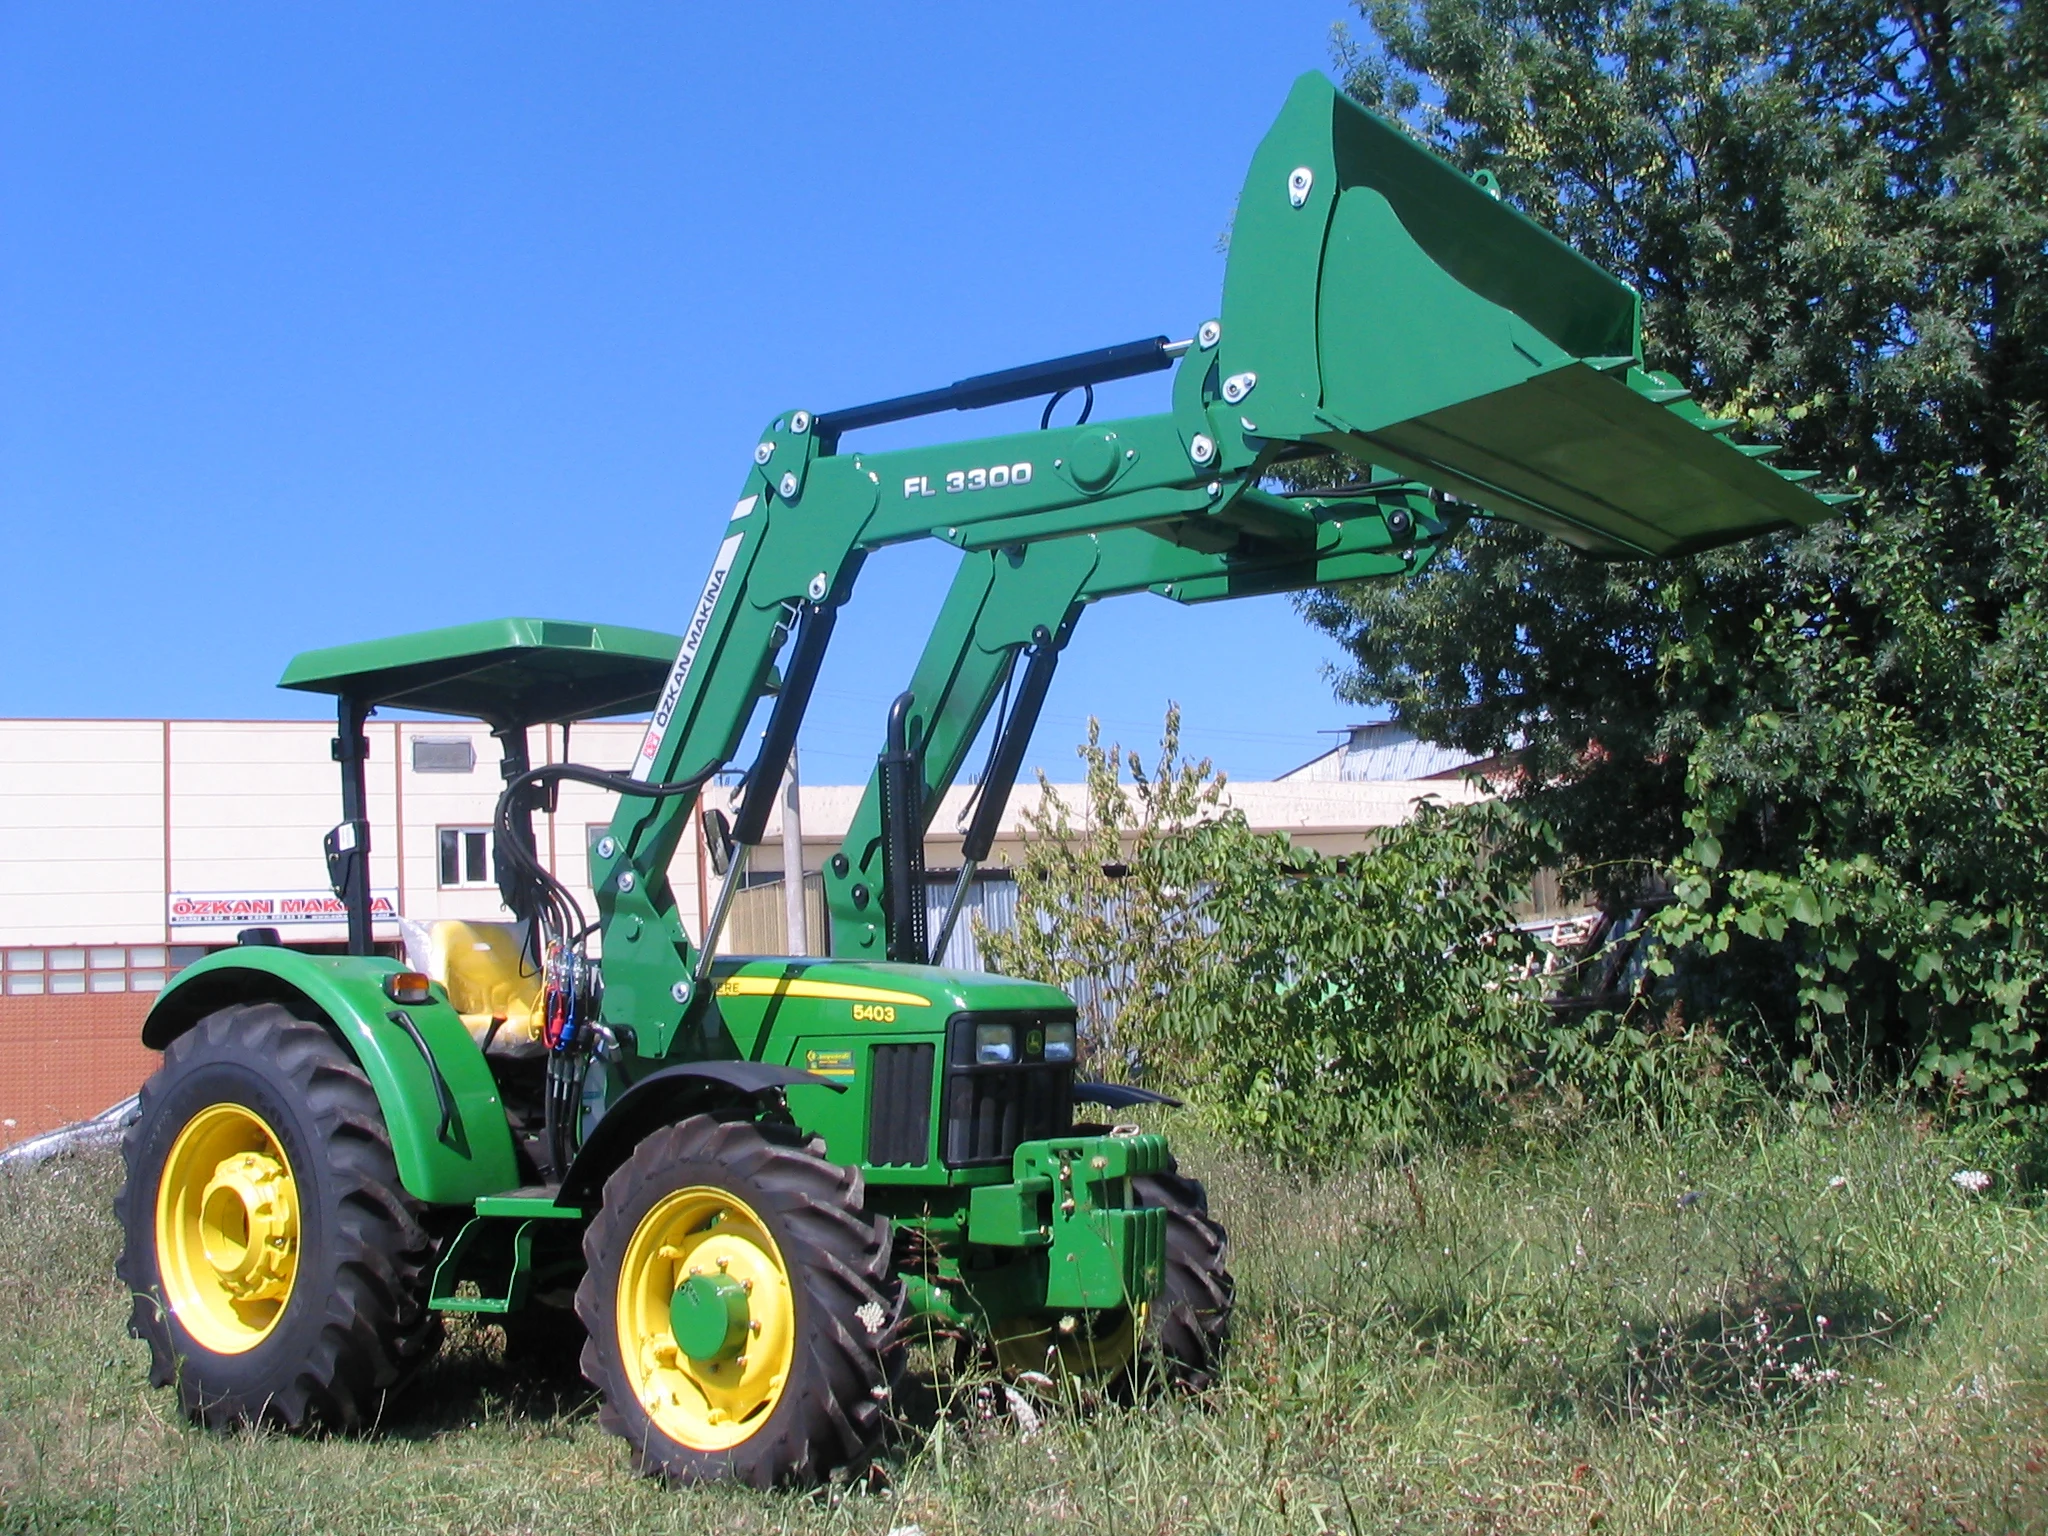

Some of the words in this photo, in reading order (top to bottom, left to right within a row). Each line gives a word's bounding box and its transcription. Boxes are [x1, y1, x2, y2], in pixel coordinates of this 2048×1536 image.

[904, 476, 936, 499] FL
[946, 462, 1032, 493] 3300
[656, 655, 691, 728] ÖZKAN
[687, 569, 726, 651] MAKİNA
[173, 898, 273, 914] ÖZKAN
[281, 898, 394, 913] MAKA
[717, 982, 740, 993] ERE
[852, 1004, 896, 1022] 5403
